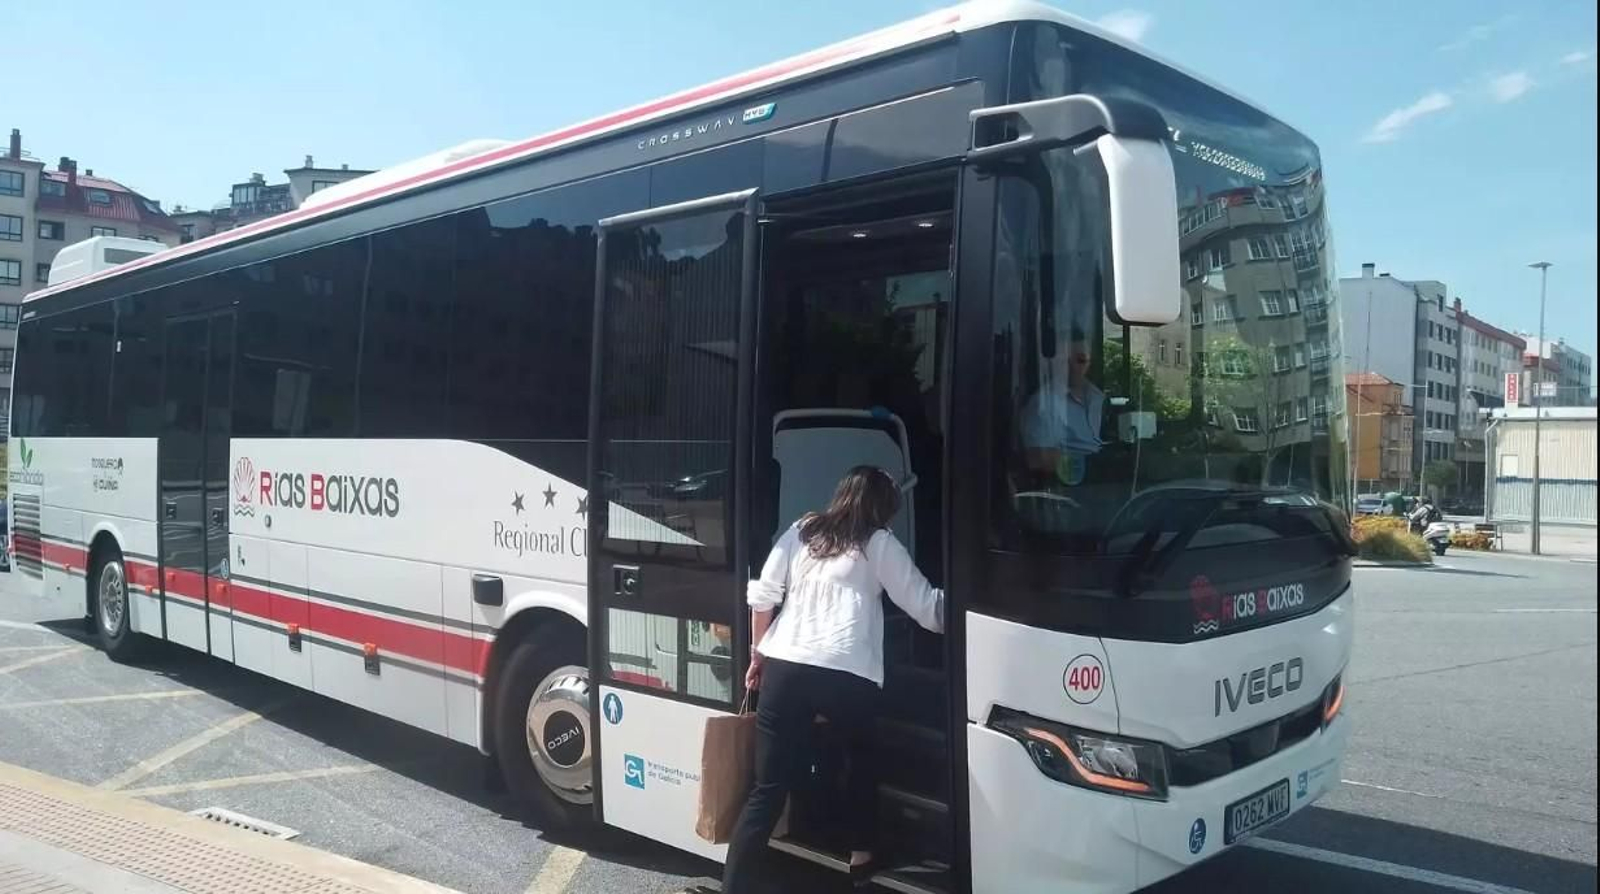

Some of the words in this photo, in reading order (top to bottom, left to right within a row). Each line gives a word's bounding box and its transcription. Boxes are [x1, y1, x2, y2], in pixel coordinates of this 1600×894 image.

[310, 473, 400, 518] Baixas
[493, 520, 565, 557] Regional
[1069, 665, 1101, 692] 400
[1214, 656, 1304, 718] IVECO
[547, 726, 580, 750] IVECO
[1235, 798, 1265, 831] 0262
